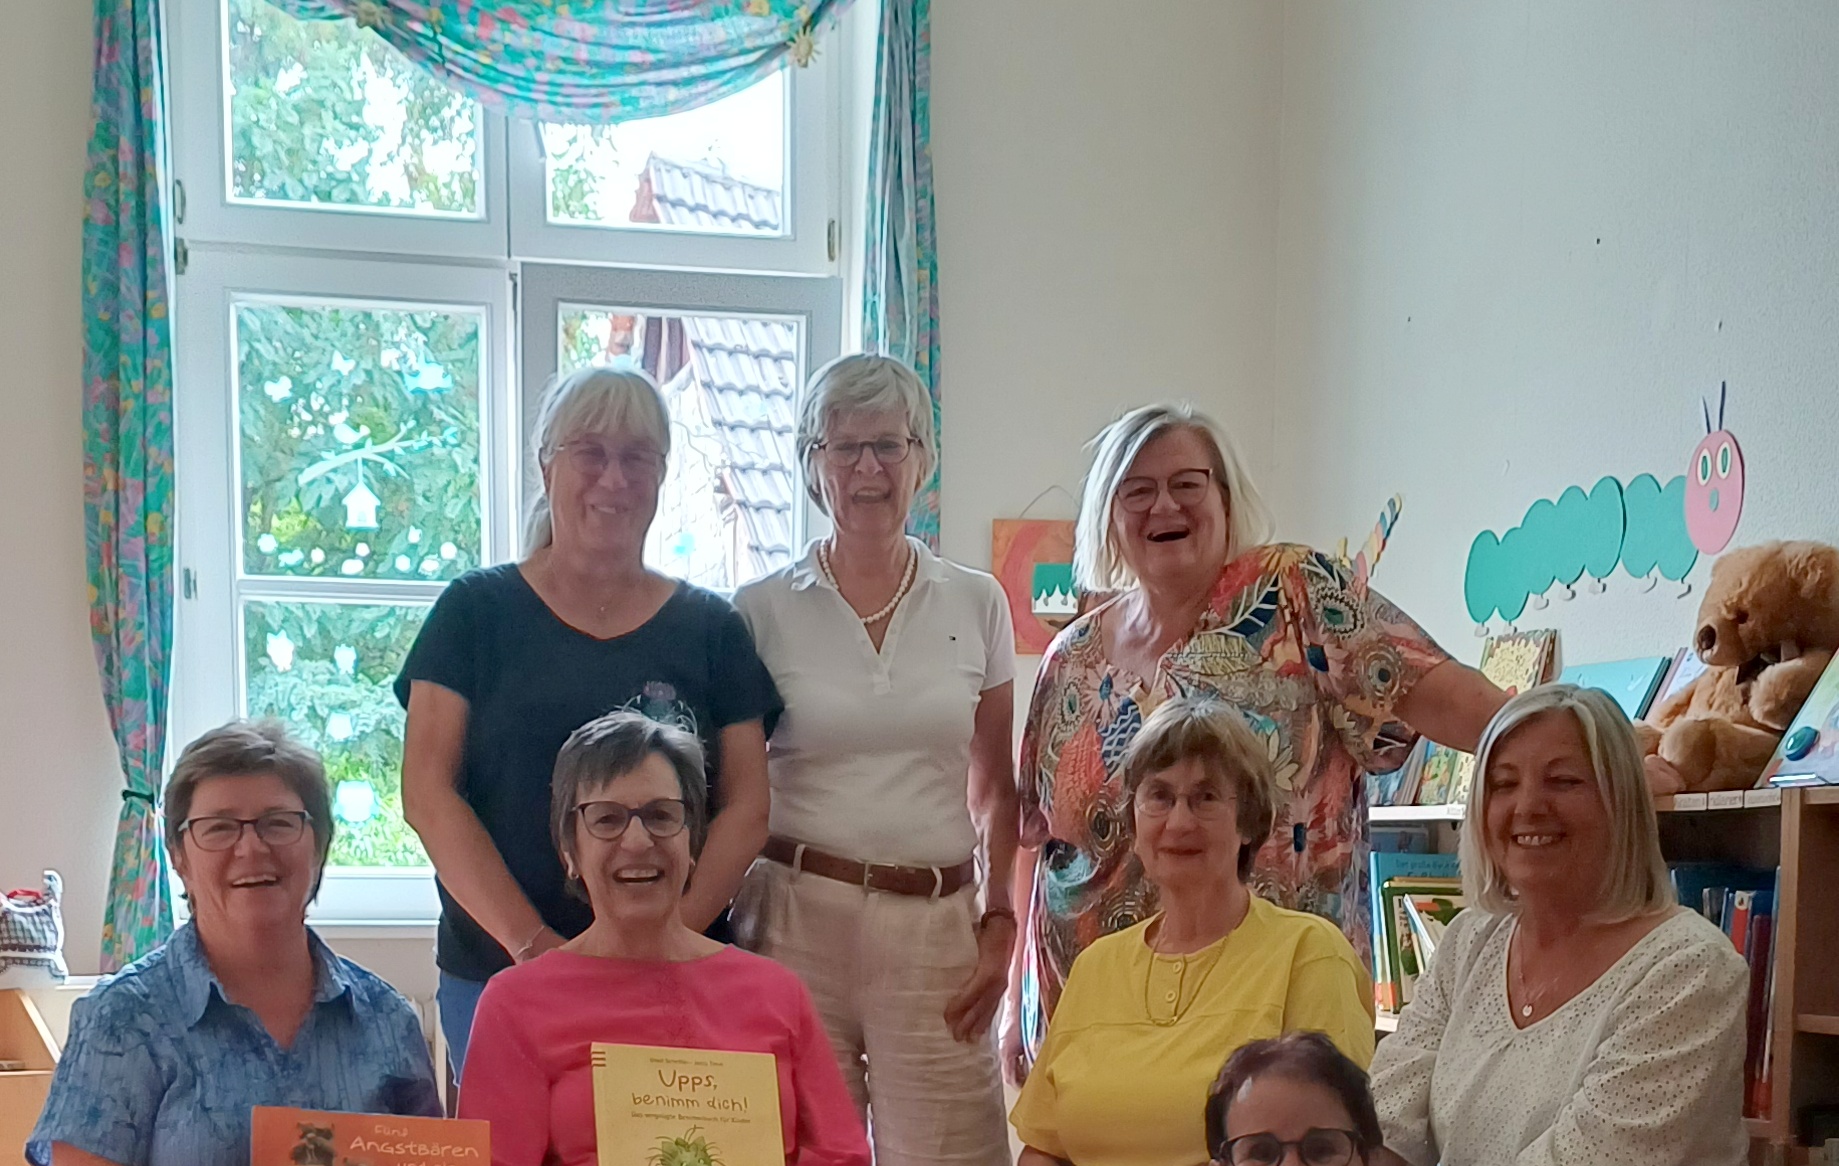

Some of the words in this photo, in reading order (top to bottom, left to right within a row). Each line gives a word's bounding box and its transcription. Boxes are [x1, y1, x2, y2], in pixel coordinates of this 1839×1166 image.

[658, 1069, 717, 1092] Upps,
[631, 1092, 700, 1109] benimm
[707, 1097, 748, 1113] dich!
